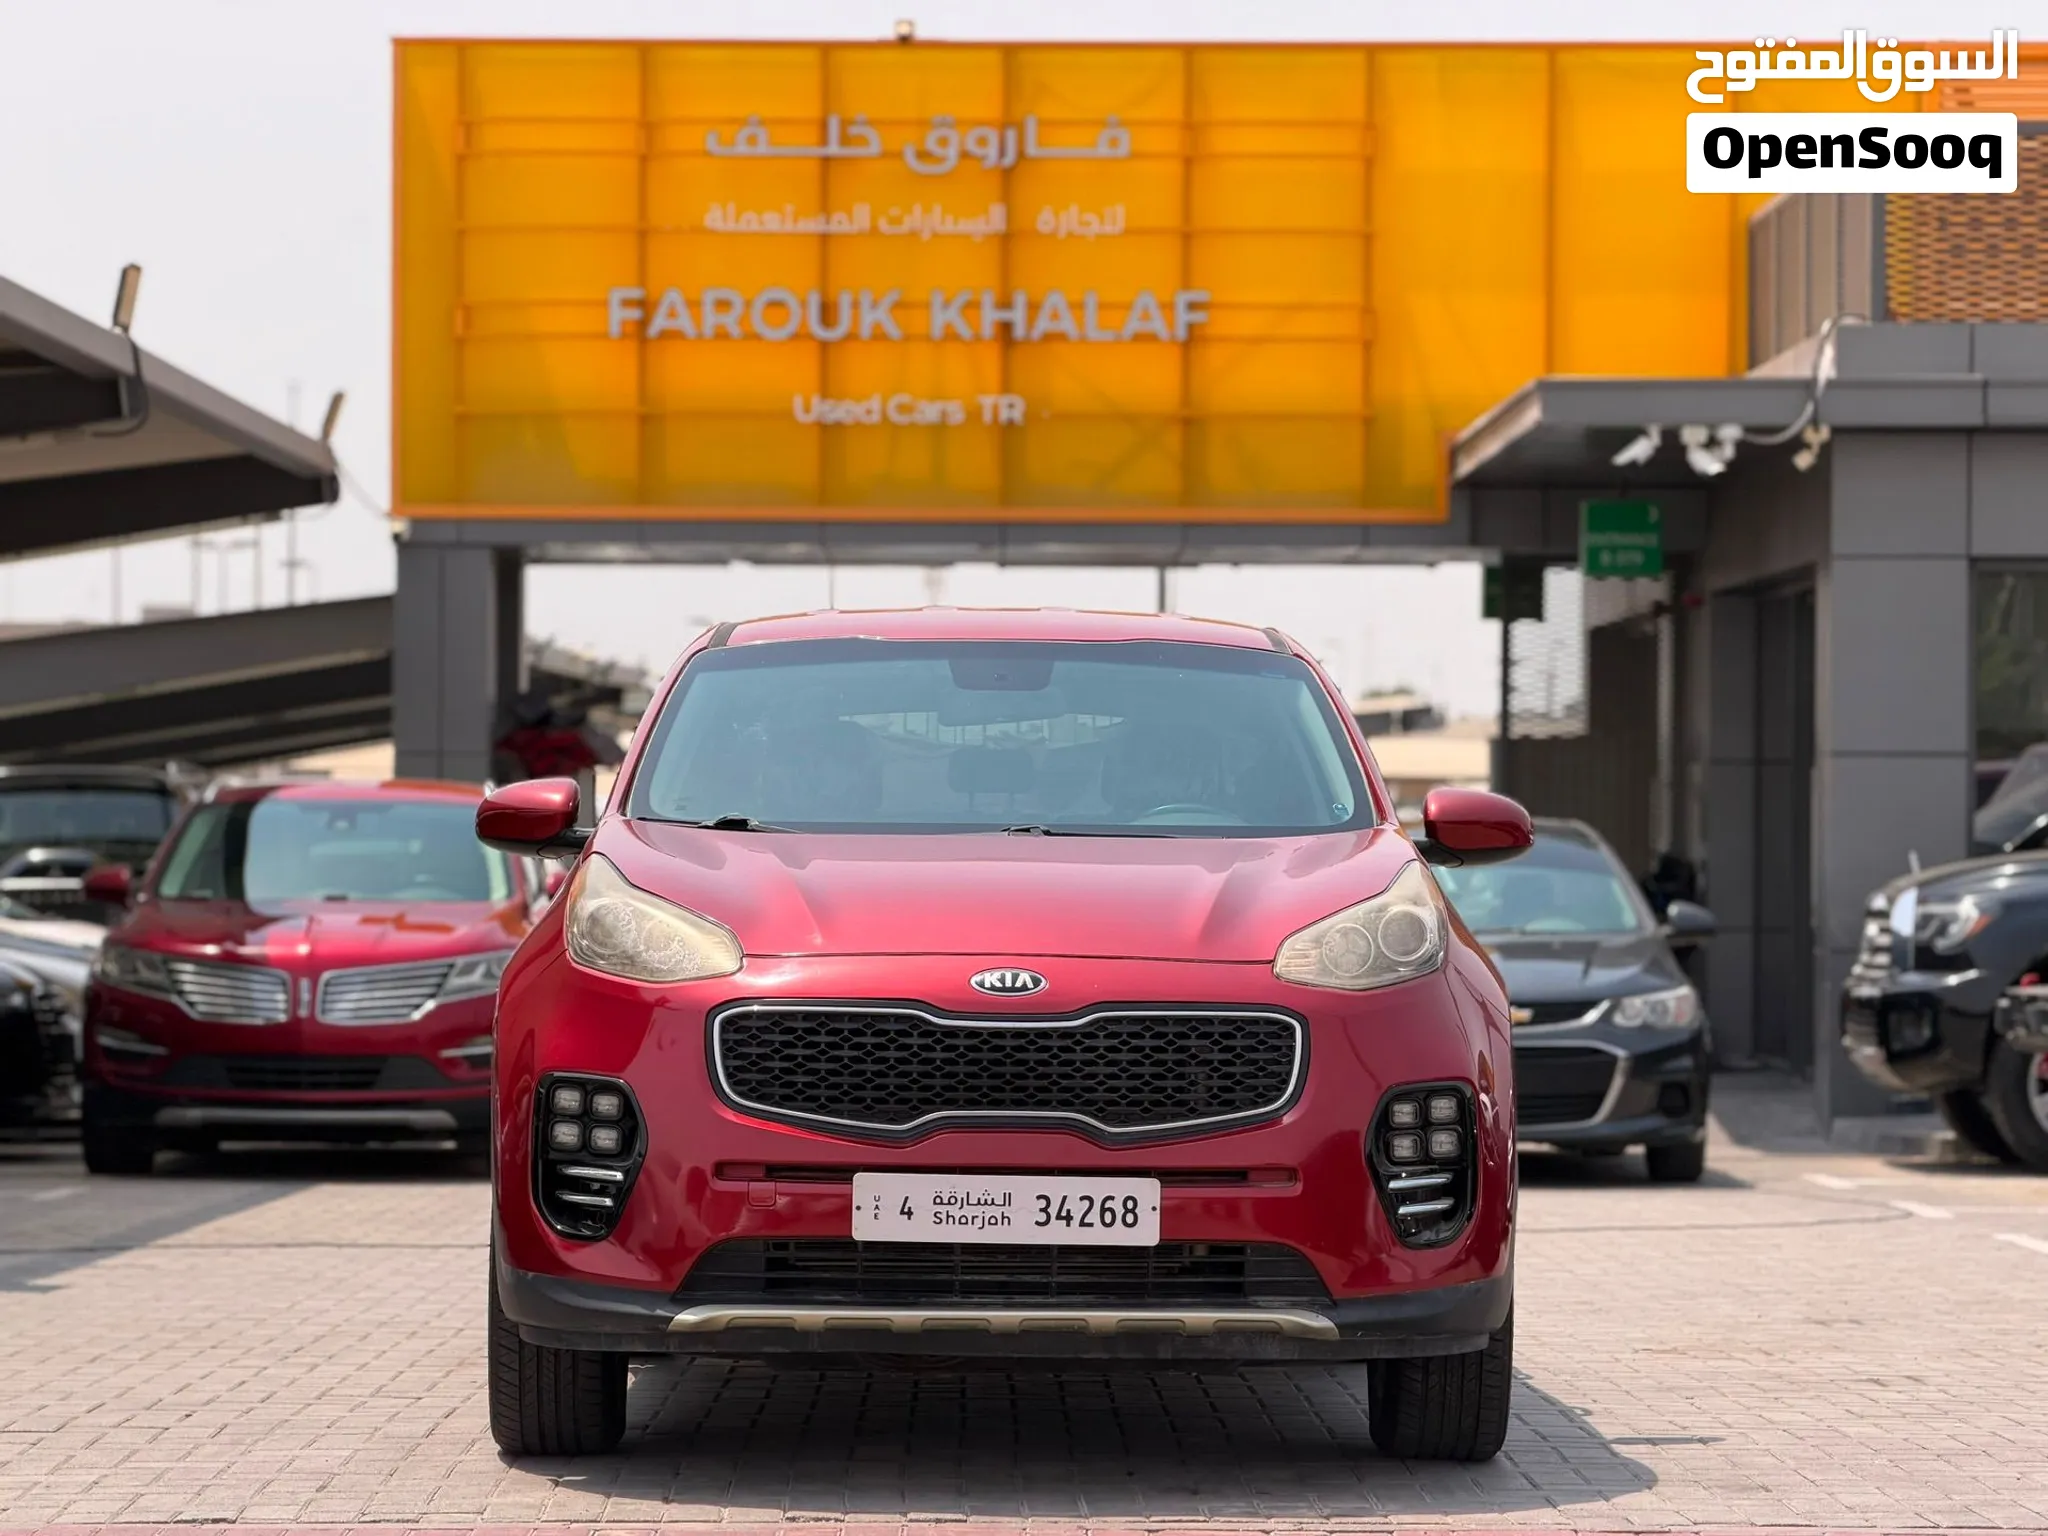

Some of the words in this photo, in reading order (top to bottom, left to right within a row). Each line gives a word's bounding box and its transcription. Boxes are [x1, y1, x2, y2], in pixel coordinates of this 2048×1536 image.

[606, 287, 904, 341] FAROUK
[929, 288, 1212, 342] KHALAF
[793, 393, 879, 424] Used
[886, 393, 966, 424] Cars
[978, 394, 1025, 424] TR
[984, 971, 1034, 989] KIA
[899, 1195, 914, 1220] 4
[1034, 1194, 1139, 1228] 34268
[932, 1188, 1012, 1210] الشارقة
[932, 1210, 1011, 1230] Sharjah
